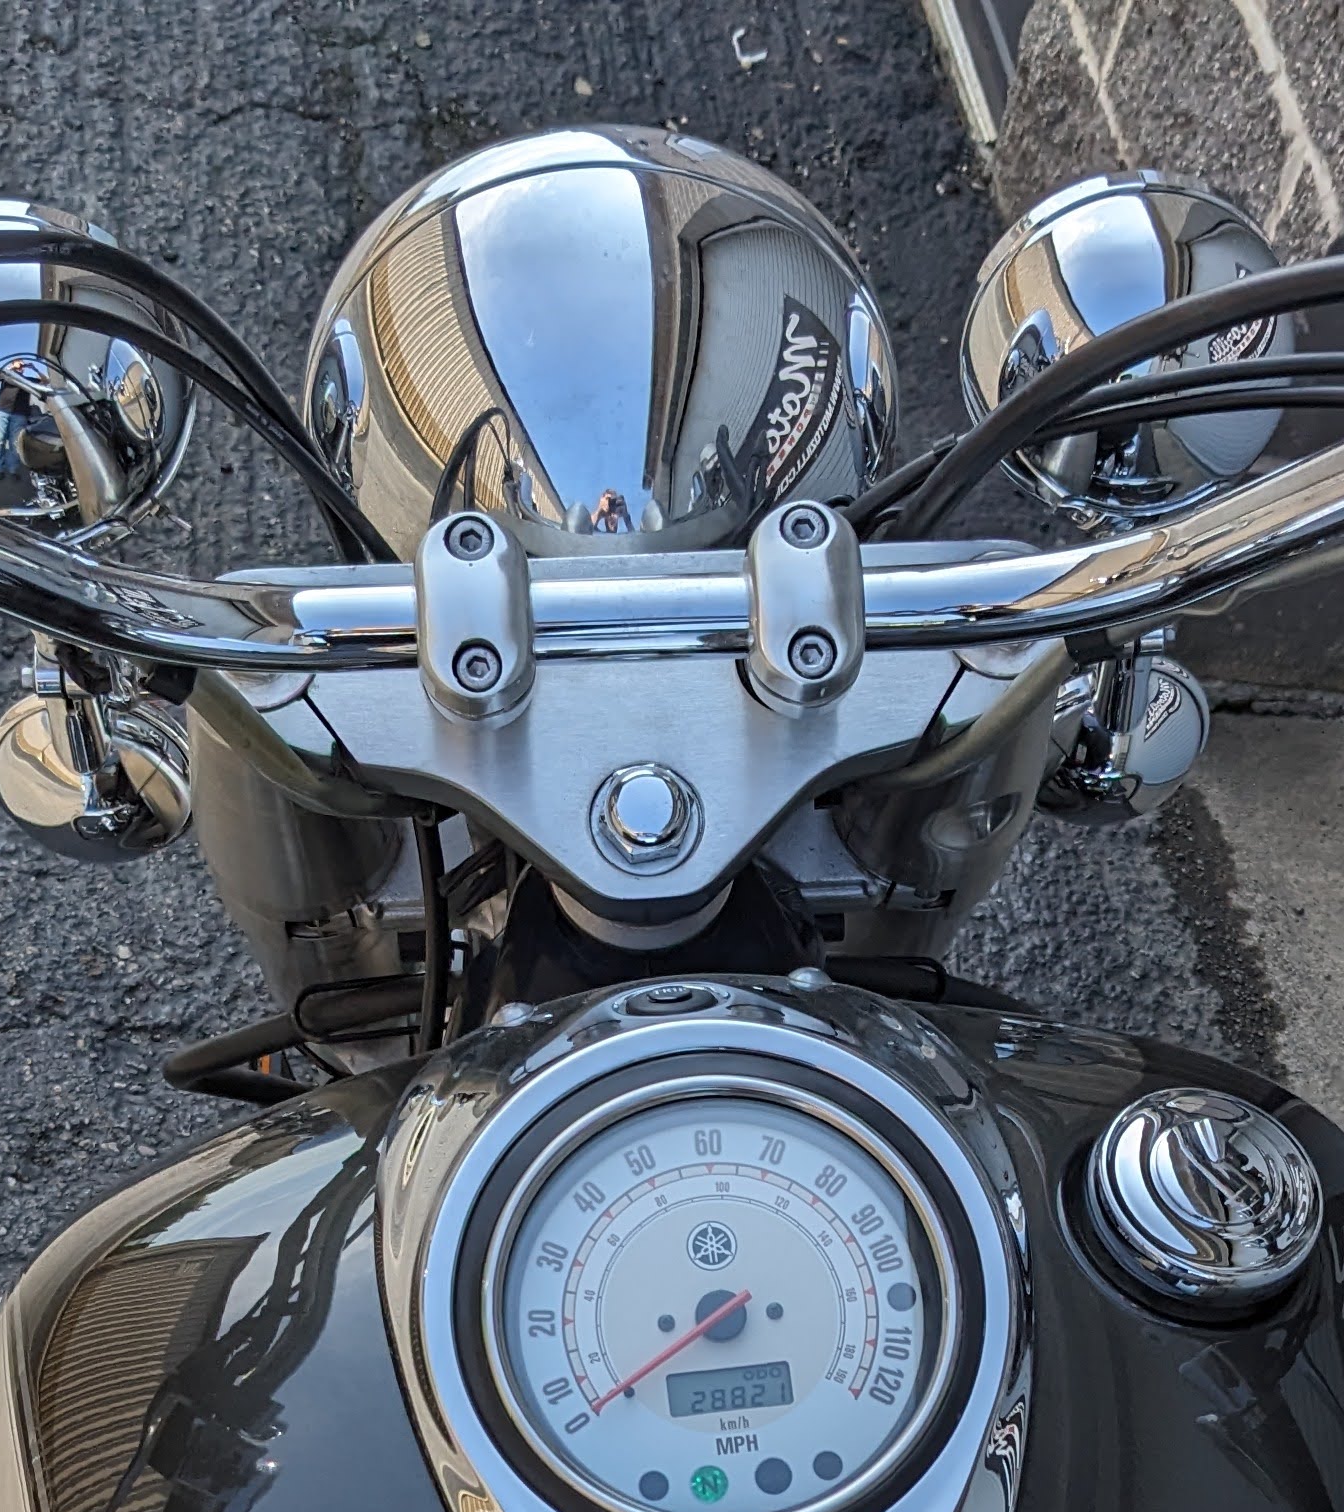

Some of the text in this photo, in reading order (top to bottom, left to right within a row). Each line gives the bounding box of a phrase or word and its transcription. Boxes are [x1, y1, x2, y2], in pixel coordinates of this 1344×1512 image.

[694, 1129, 722, 1156] 60
[758, 1135, 786, 1165] 70
[623, 1144, 656, 1177] 50
[715, 1181, 730, 1193] 100
[814, 1164, 848, 1198] 80
[572, 1181, 607, 1213] 40
[654, 1194, 668, 1208] 80
[774, 1195, 790, 1210] 120
[851, 1204, 884, 1236] 90
[607, 1233, 621, 1247] 60
[817, 1230, 833, 1248] 140
[536, 1241, 569, 1272] 30
[868, 1234, 904, 1273] 100
[584, 1289, 596, 1302] 40
[844, 1287, 858, 1303] 160
[528, 1310, 556, 1338] 20
[843, 1344, 856, 1360] 180
[882, 1326, 913, 1361] 110
[588, 1351, 601, 1364] 20
[743, 1366, 781, 1381] ODO
[833, 1368, 848, 1384] 190
[542, 1377, 573, 1405] 10
[869, 1364, 905, 1406] 120
[691, 1382, 786, 1413] 28821
[564, 1412, 591, 1434] 0
[719, 1415, 750, 1431] km/h
[715, 1434, 759, 1456] MPH
